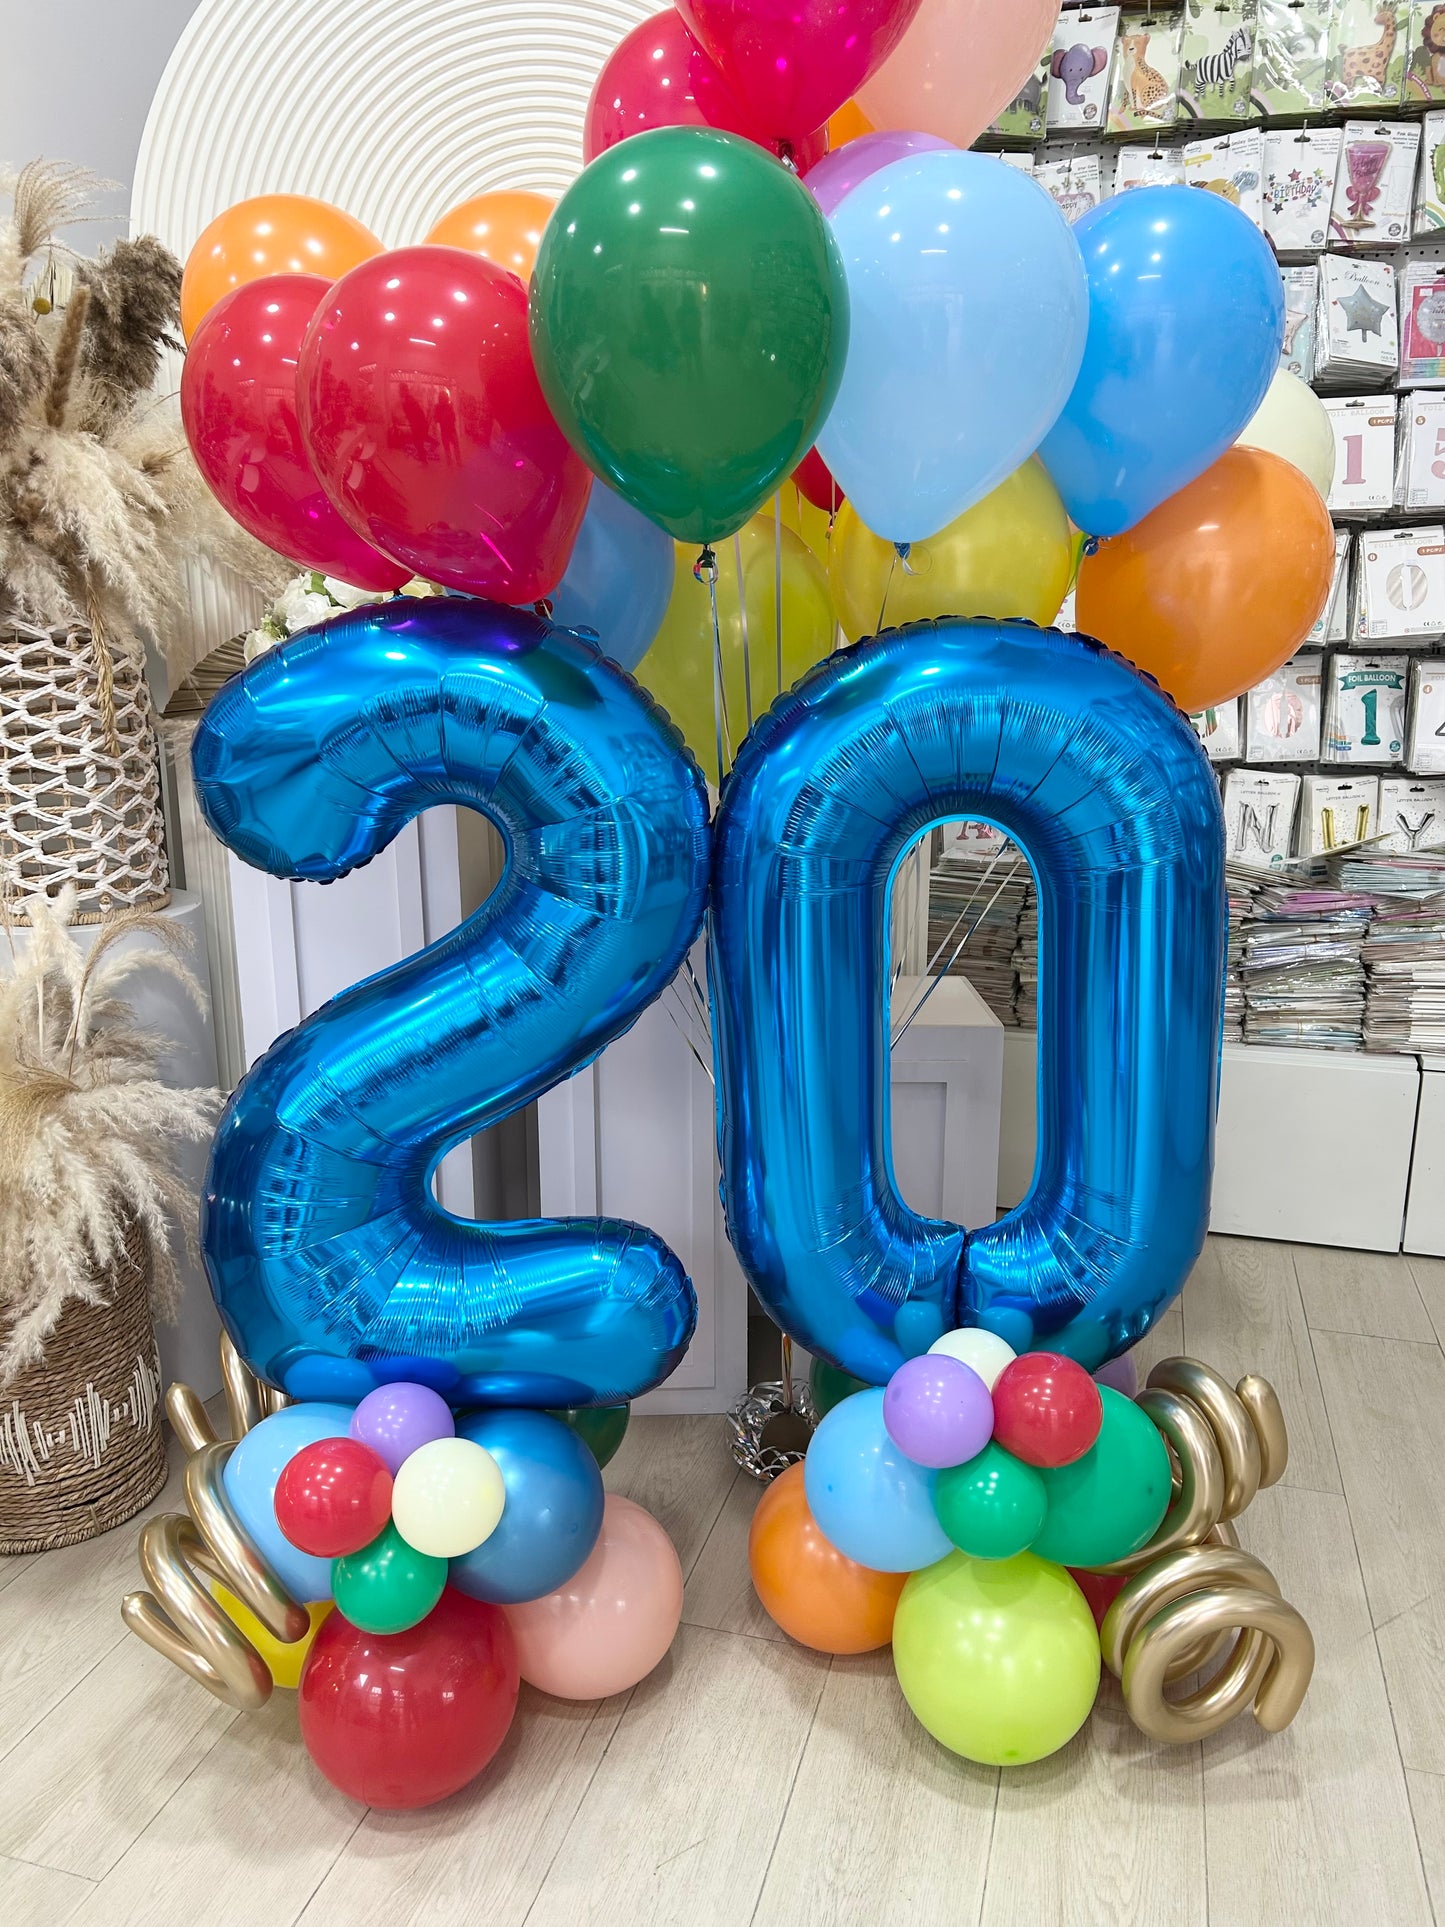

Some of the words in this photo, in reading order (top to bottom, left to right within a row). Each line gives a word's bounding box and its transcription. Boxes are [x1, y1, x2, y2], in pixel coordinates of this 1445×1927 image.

[1274, 184, 1317, 199] BIRTHDAY
[1344, 270, 1380, 286] Balloon
[1342, 434, 1366, 485] 1
[1348, 675, 1363, 683] FOIL
[1363, 674, 1397, 682] BALLOON
[1361, 688, 1381, 745] 1
[1235, 801, 1280, 853] N
[1395, 809, 1436, 851] Y
